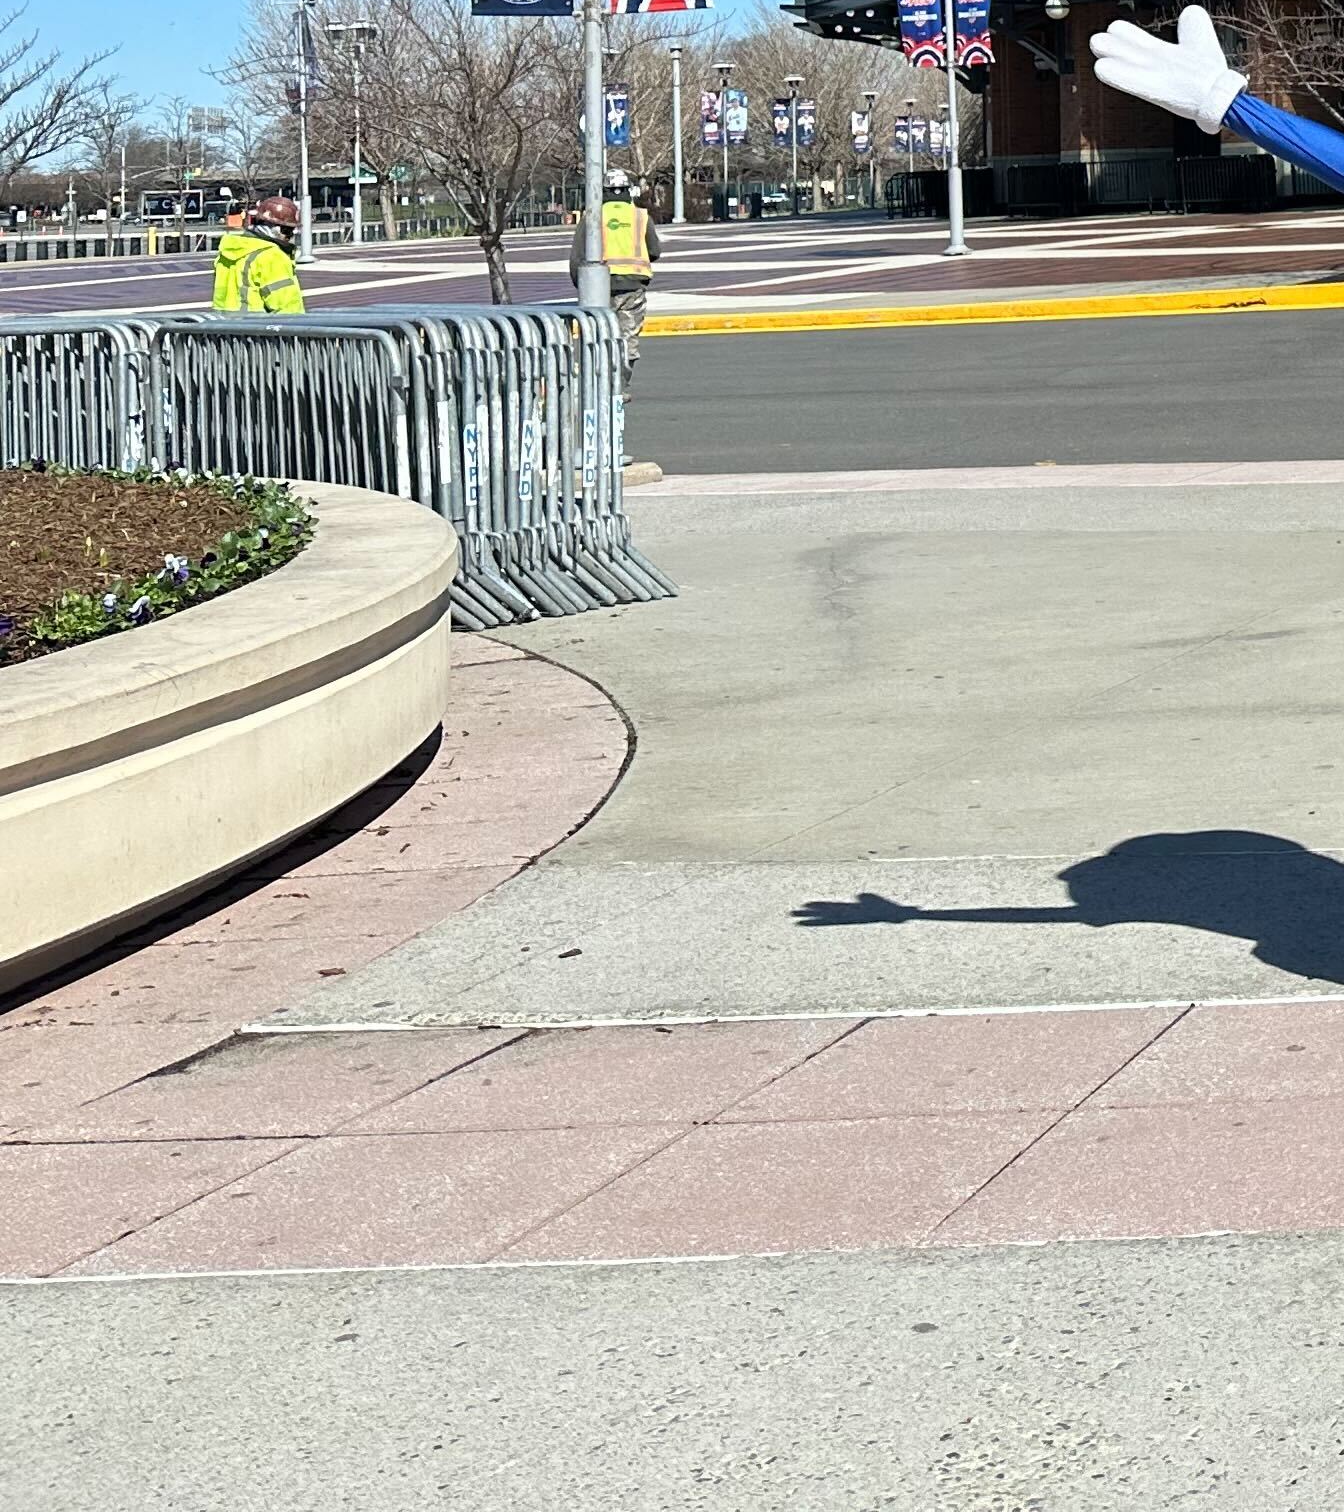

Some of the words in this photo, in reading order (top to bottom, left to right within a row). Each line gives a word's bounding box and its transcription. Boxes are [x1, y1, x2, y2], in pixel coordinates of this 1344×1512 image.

[466, 429, 478, 501] NYPD
[521, 423, 534, 496] NYPD
[585, 415, 596, 483] NYPD
